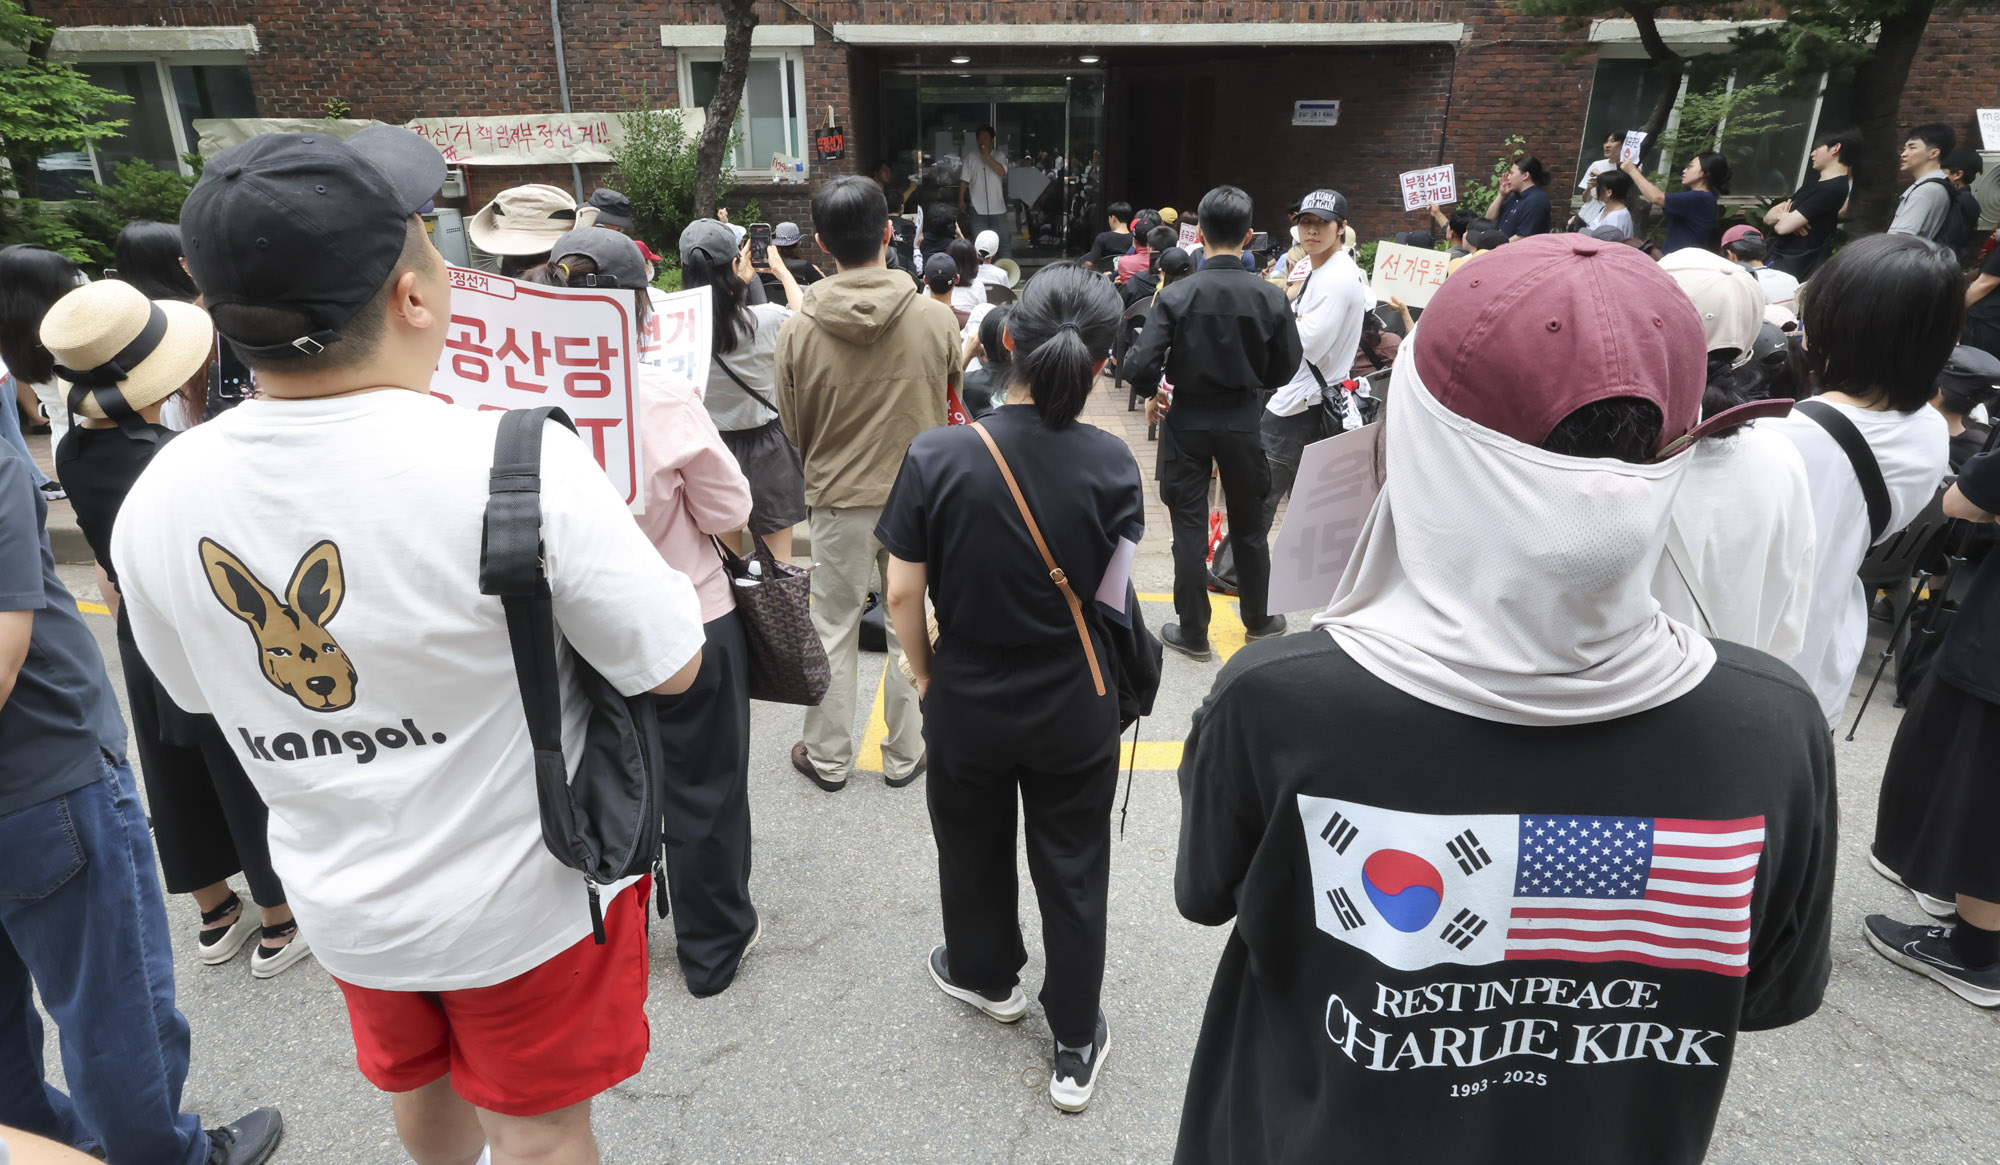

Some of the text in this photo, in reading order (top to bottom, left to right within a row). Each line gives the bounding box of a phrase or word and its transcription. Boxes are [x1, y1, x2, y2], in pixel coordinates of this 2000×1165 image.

[1405, 170, 1451, 189] 부정선거
[1408, 186, 1452, 206] 중국개입
[1380, 253, 1445, 286] 선거무효
[438, 314, 619, 399] 공산당
[1372, 977, 1661, 1018] REST IN PEACE
[1325, 993, 1726, 1072] CHARLIE KIRK
[1450, 1079, 1488, 1098] 1993
[1503, 1069, 1548, 1087] 2025
